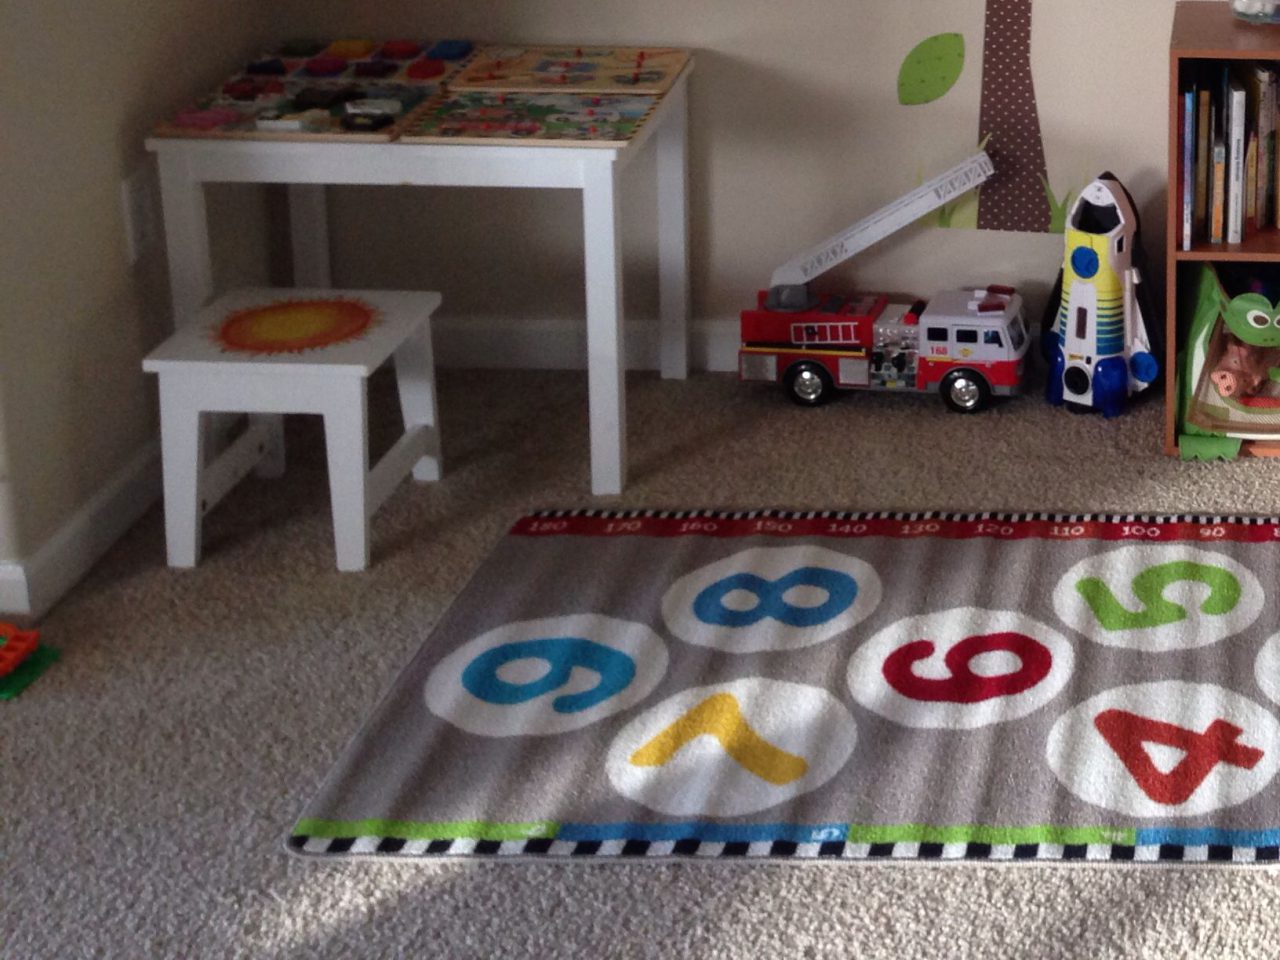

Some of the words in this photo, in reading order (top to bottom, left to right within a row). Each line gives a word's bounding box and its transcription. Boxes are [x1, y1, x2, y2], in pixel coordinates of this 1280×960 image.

[605, 520, 641, 532] 170
[753, 521, 792, 532] 150
[829, 521, 866, 533] 140
[901, 523, 940, 534] 130
[976, 523, 1013, 535] 120
[1050, 525, 1084, 536] 110
[1122, 526, 1160, 537] 100
[1200, 527, 1225, 538] 90
[692, 566, 859, 627] 8
[1075, 560, 1242, 632] 5
[629, 693, 808, 786] 7
[1094, 708, 1265, 805] 4
